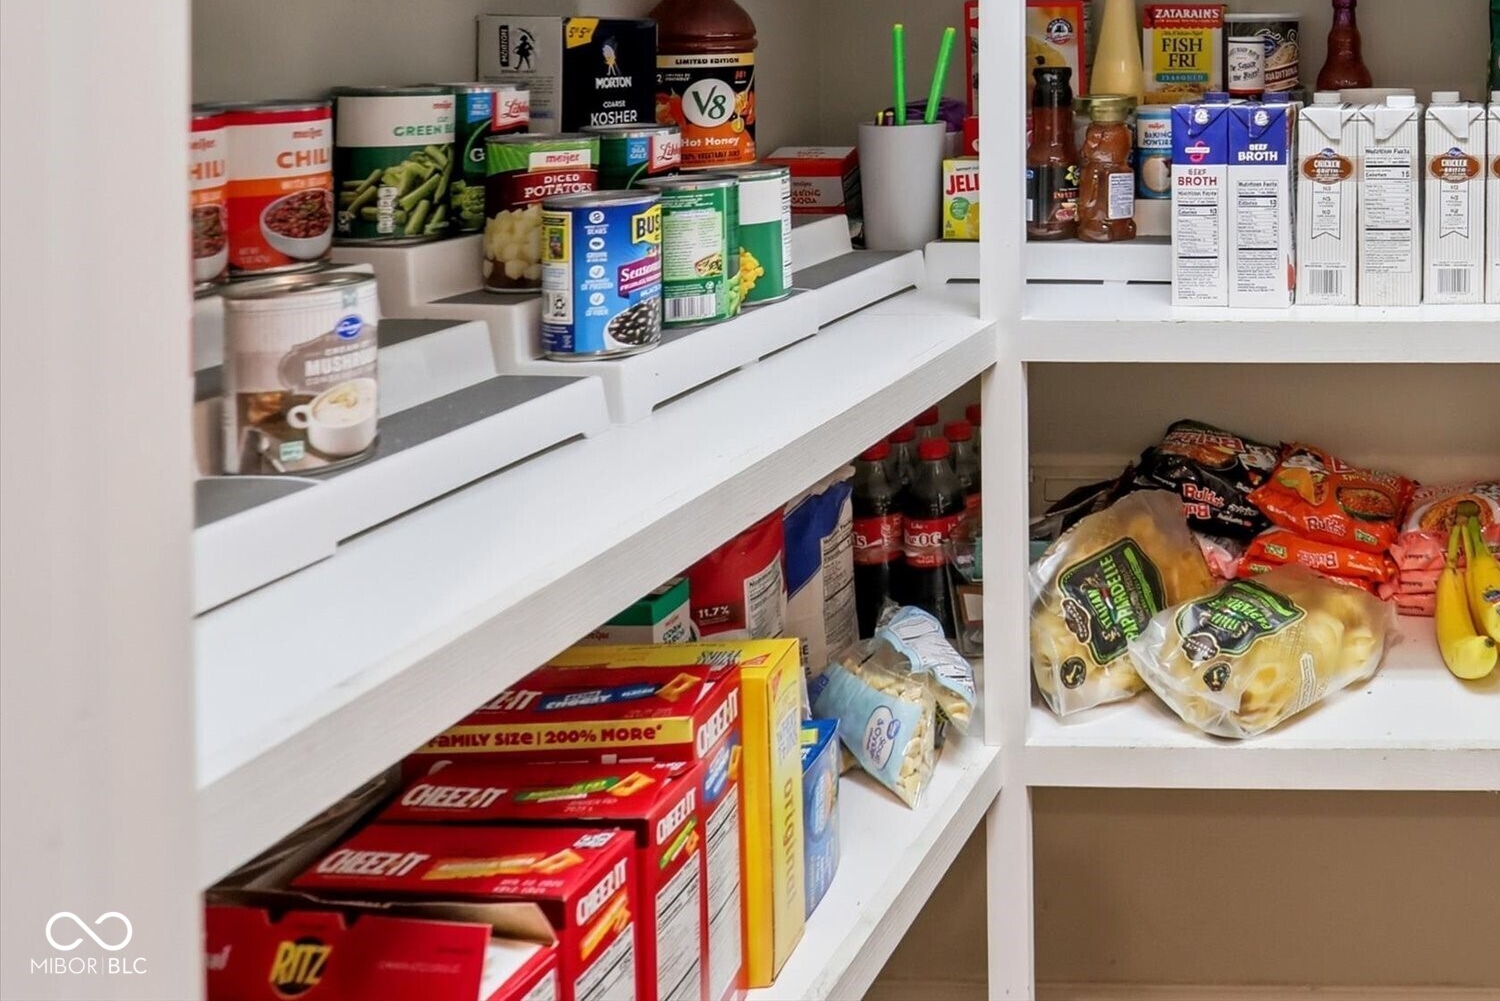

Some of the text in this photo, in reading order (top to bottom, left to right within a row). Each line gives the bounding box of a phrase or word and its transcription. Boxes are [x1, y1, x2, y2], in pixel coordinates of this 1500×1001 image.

[1155, 8, 1220, 19] ZATARAIN'S
[1162, 37, 1202, 52] FISH
[1168, 53, 1196, 68] FRI
[595, 76, 633, 89] MORTON
[692, 85, 727, 120] V8
[590, 109, 638, 126] KOSHER
[393, 123, 443, 137] GREEN
[704, 136, 740, 147] Honey
[1238, 151, 1278, 161] BROTH
[543, 174, 581, 185] DICED
[1178, 176, 1218, 186] BROTH
[523, 183, 593, 198] POTATOES
[636, 214, 661, 240] BUS
[545, 728, 597, 744] 200%
[269, 939, 334, 987] RITZ
